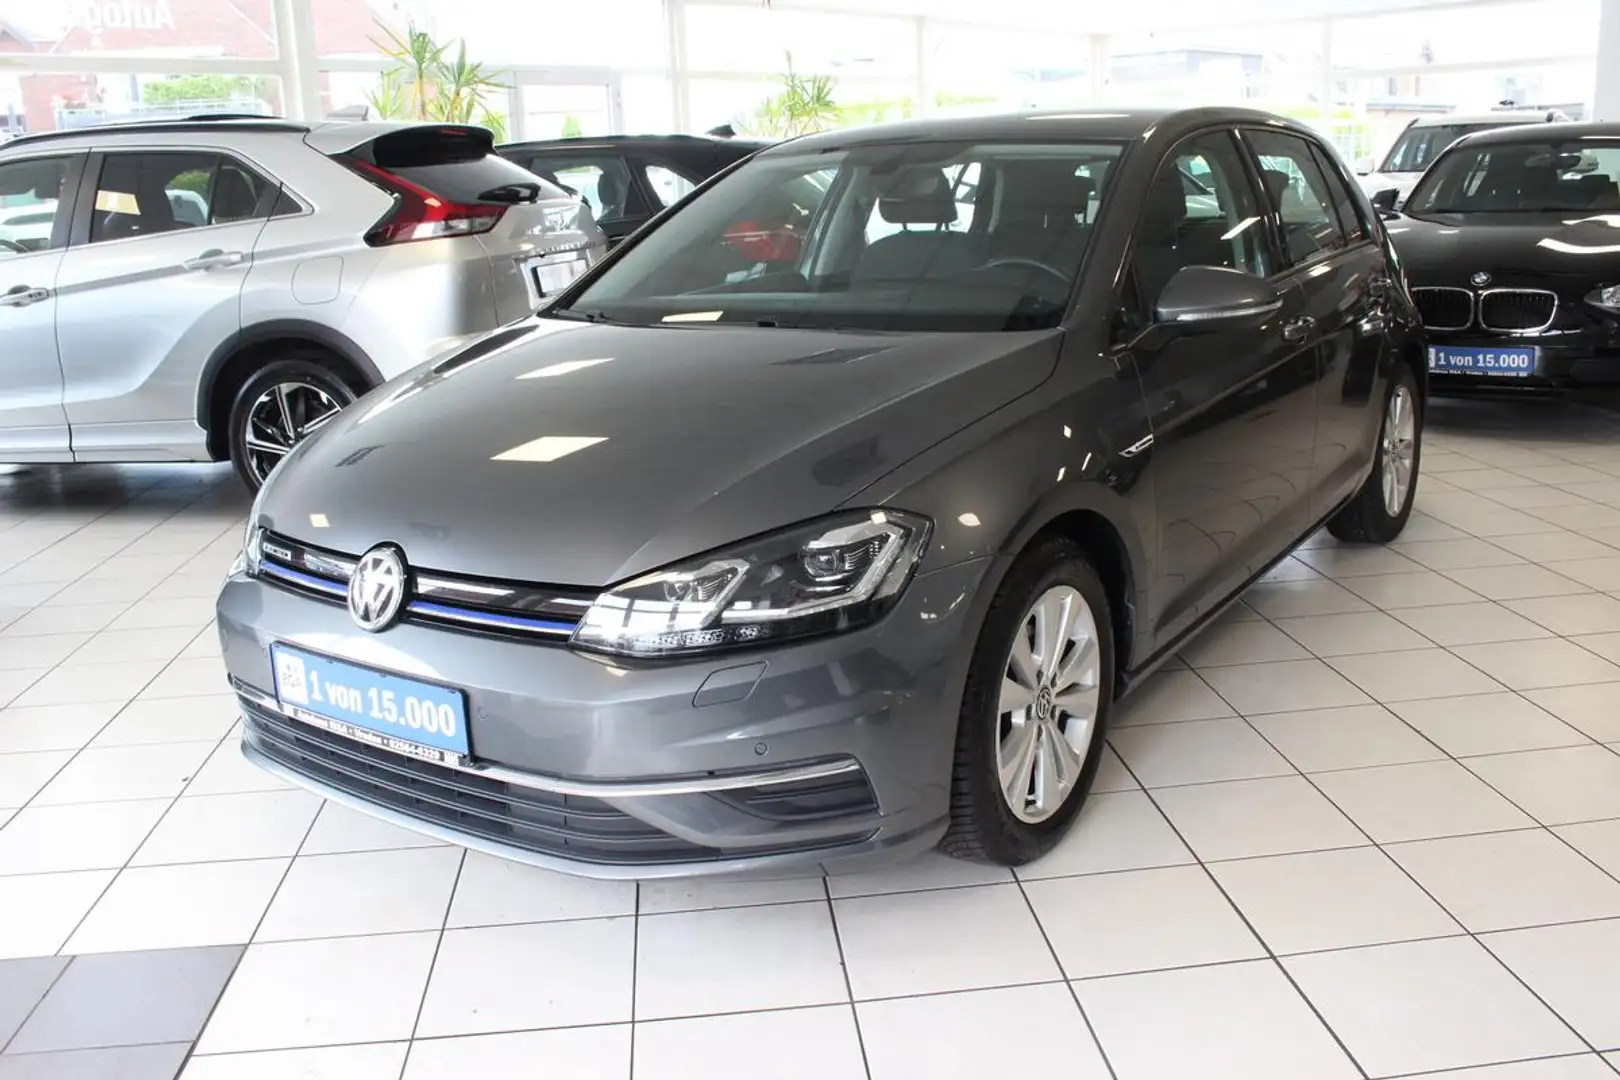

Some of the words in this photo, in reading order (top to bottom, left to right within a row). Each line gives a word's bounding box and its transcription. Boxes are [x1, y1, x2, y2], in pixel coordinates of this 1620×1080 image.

[1438, 352, 1446, 365] 1
[1449, 355, 1472, 366] von
[1477, 354, 1529, 368] 15.000
[310, 670, 323, 702] 1
[326, 682, 363, 714] von
[368, 687, 455, 737] 15.000
